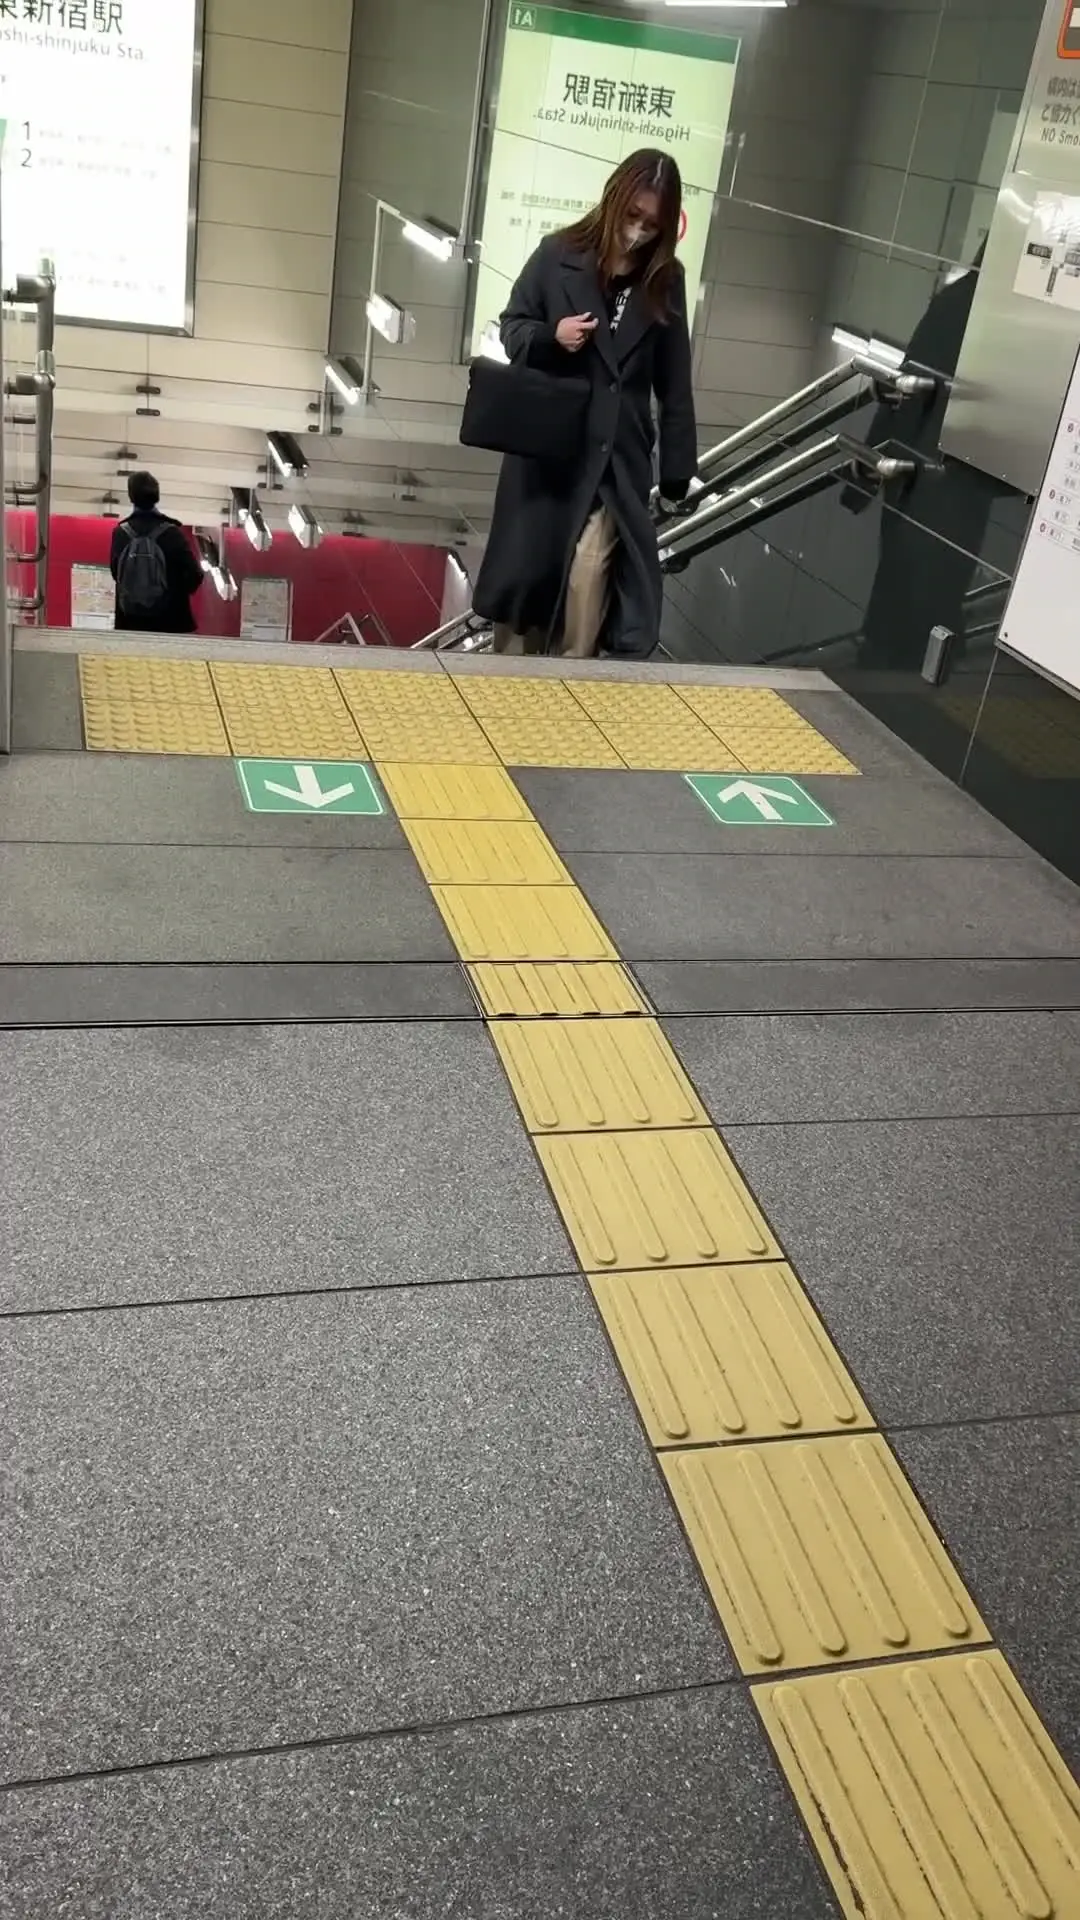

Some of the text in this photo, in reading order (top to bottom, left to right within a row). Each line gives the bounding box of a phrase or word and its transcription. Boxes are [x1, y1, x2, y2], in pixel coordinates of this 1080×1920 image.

[21, 121, 32, 141] 1
[1040, 127, 1080, 147] NO Smo
[20, 148, 33, 168] 2
